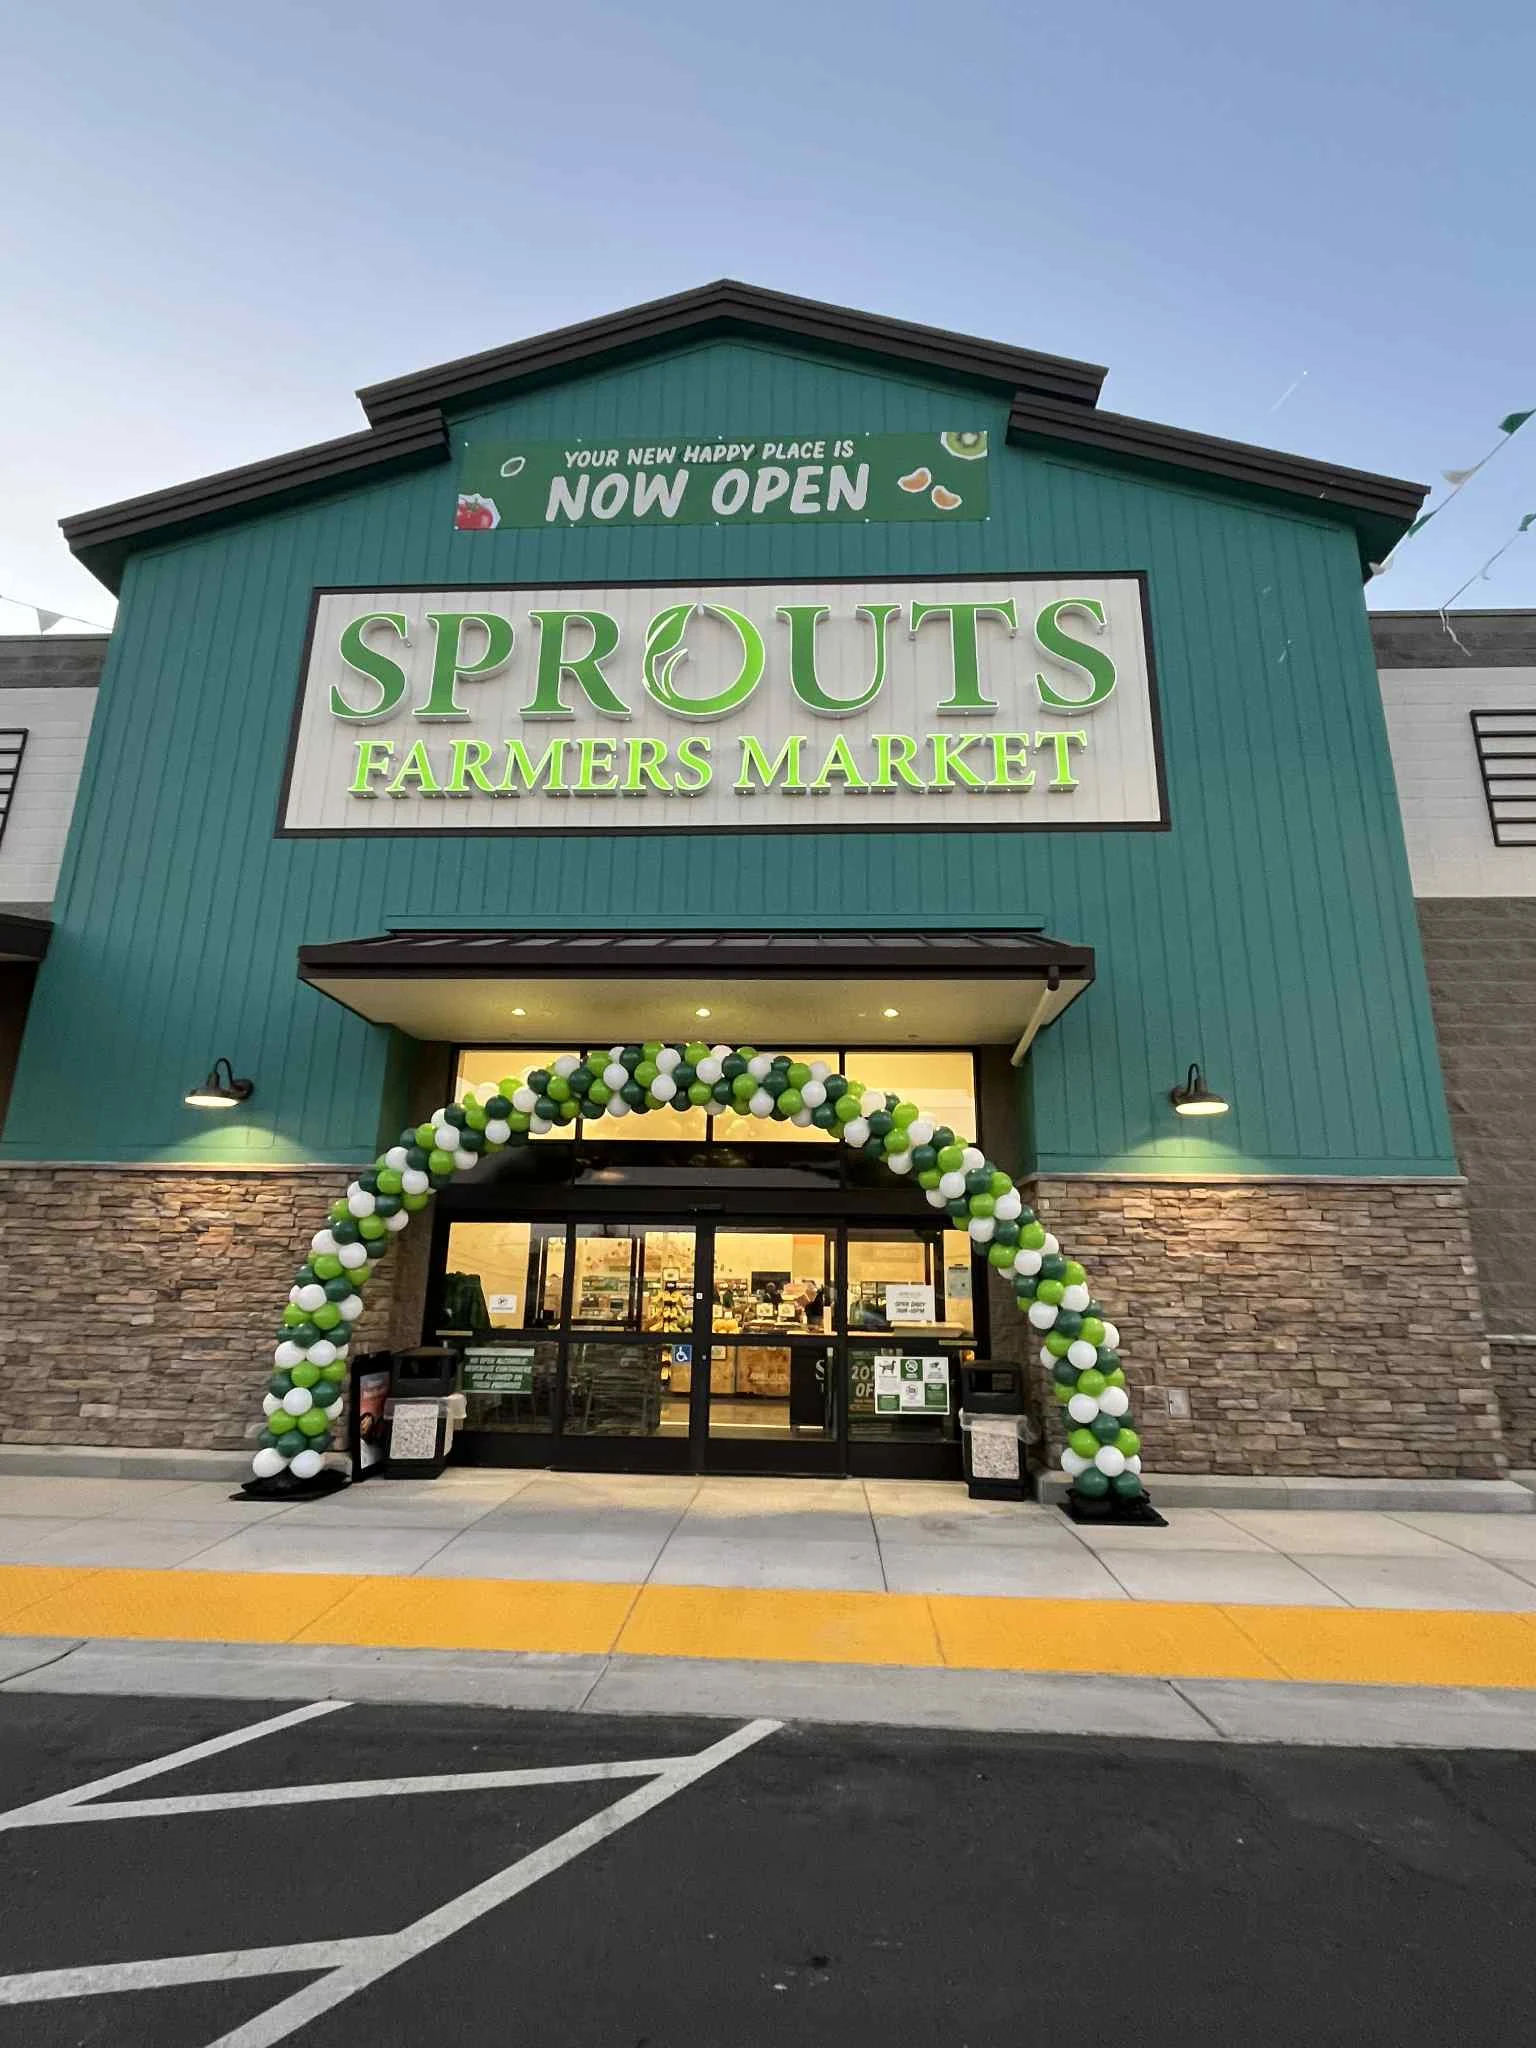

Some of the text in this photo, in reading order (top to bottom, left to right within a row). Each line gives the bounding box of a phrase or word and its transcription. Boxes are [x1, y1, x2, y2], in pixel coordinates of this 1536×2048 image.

[565, 440, 854, 468] YOUR NEW HAPPY PLACE IS
[545, 463, 870, 522] NOW OPEN
[329, 597, 1117, 721] SPROUTS
[348, 730, 1088, 793] FARMERS MARKET
